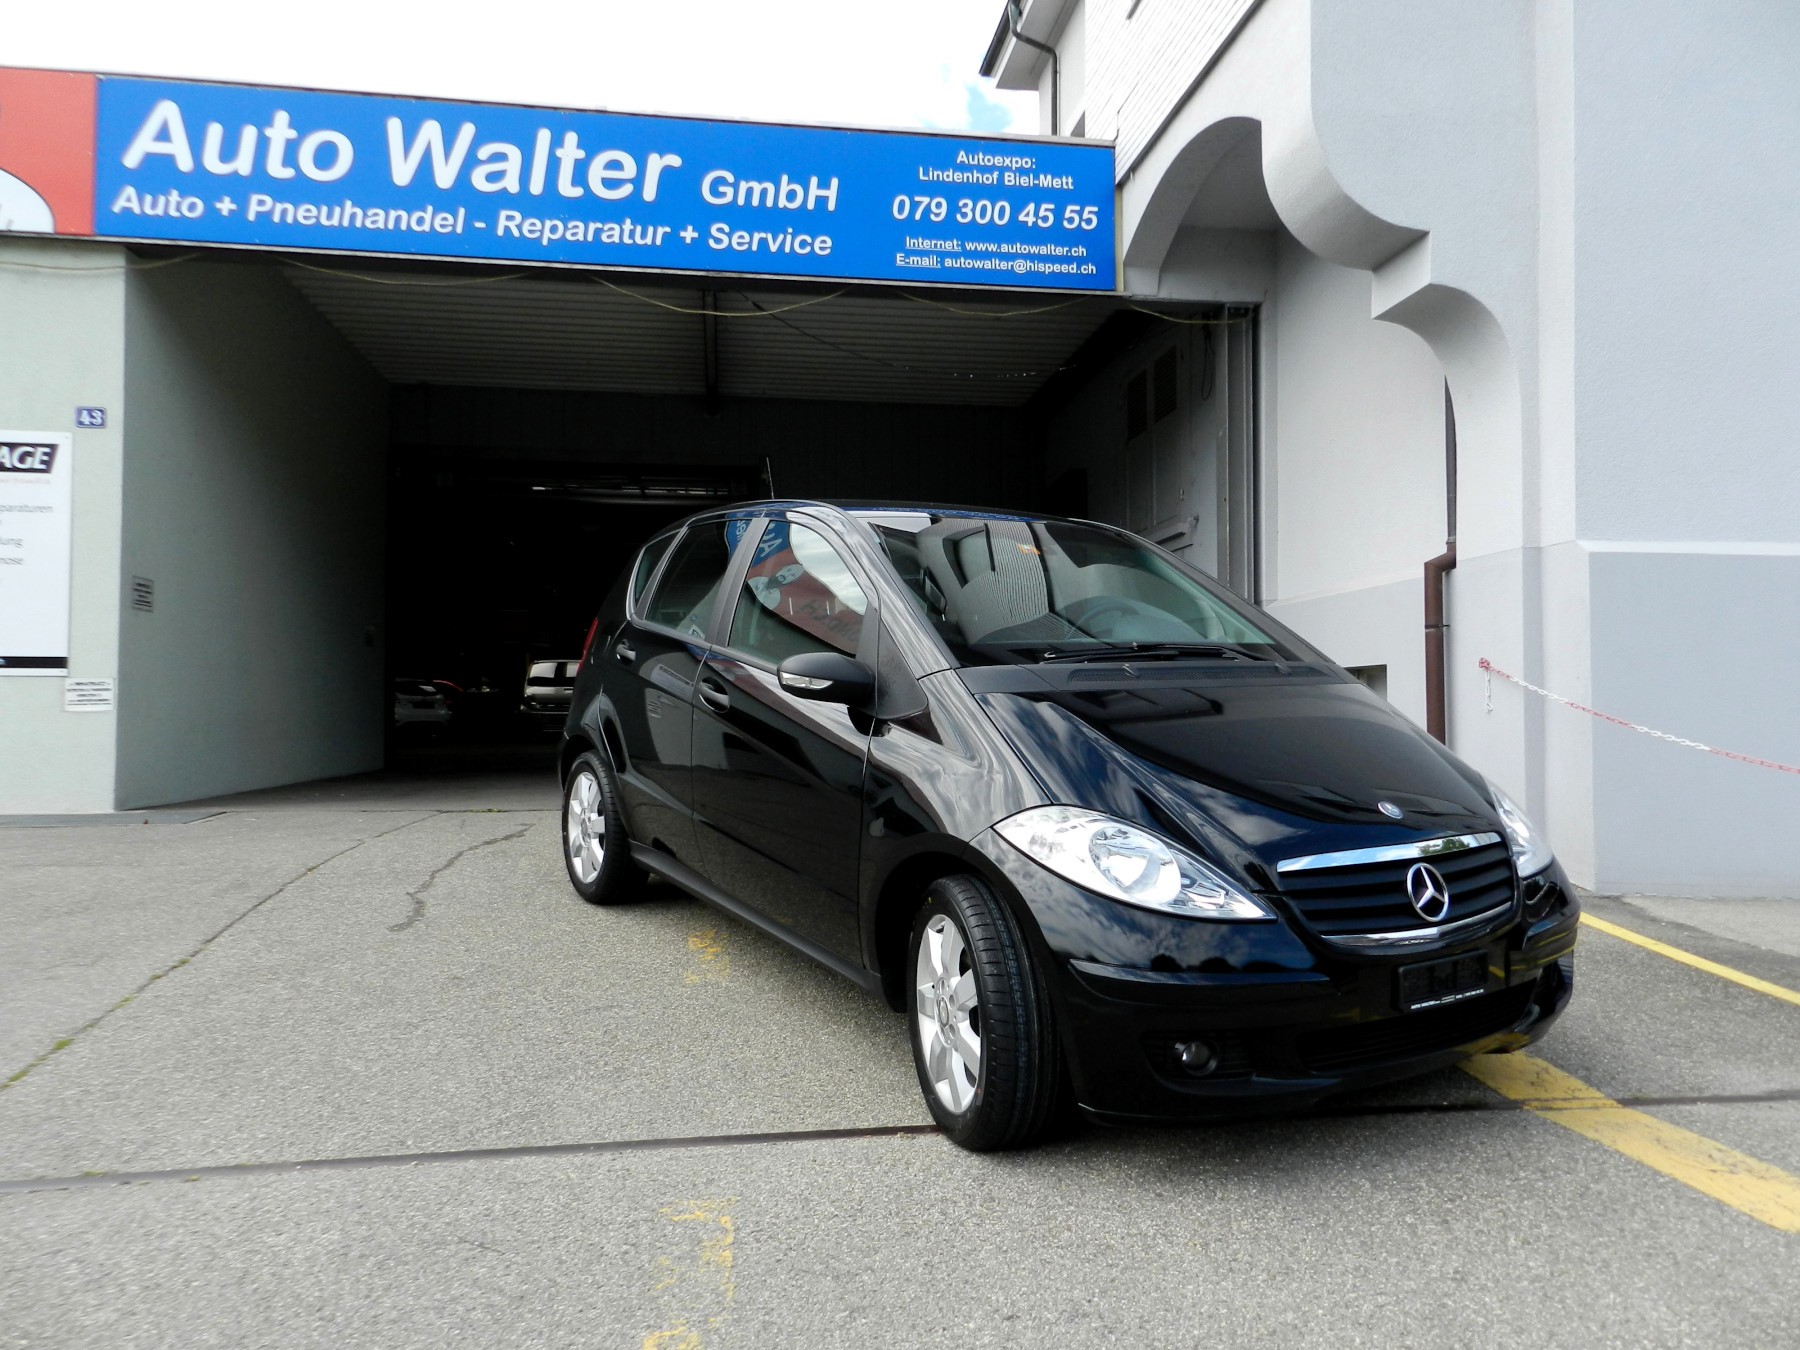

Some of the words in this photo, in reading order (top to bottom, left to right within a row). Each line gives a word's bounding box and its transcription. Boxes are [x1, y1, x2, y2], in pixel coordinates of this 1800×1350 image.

[120, 99, 354, 183] Auto
[386, 116, 683, 203] Walter
[701, 169, 840, 212] GmbH
[956, 150, 1036, 170] Autoexpo:
[919, 166, 999, 185] Lindenhof
[1003, 171, 1074, 190] Biel-Mett
[111, 184, 205, 220] Auto
[214, 195, 238, 218] +
[246, 193, 466, 234] Pneuhandel
[498, 208, 671, 247] Reparatur
[680, 224, 699, 246] +
[708, 222, 833, 257] Service
[892, 194, 948, 222] 079
[956, 198, 1011, 226] 300
[1018, 202, 1055, 228] 45
[1063, 205, 1099, 231] 55
[905, 236, 962, 252] Internet:
[965, 240, 1087, 257] www.autowalter.ch
[896, 253, 941, 268] E-mail:
[944, 257, 1097, 275] autowalter@hispeed.ch
[79, 409, 103, 426] 43
